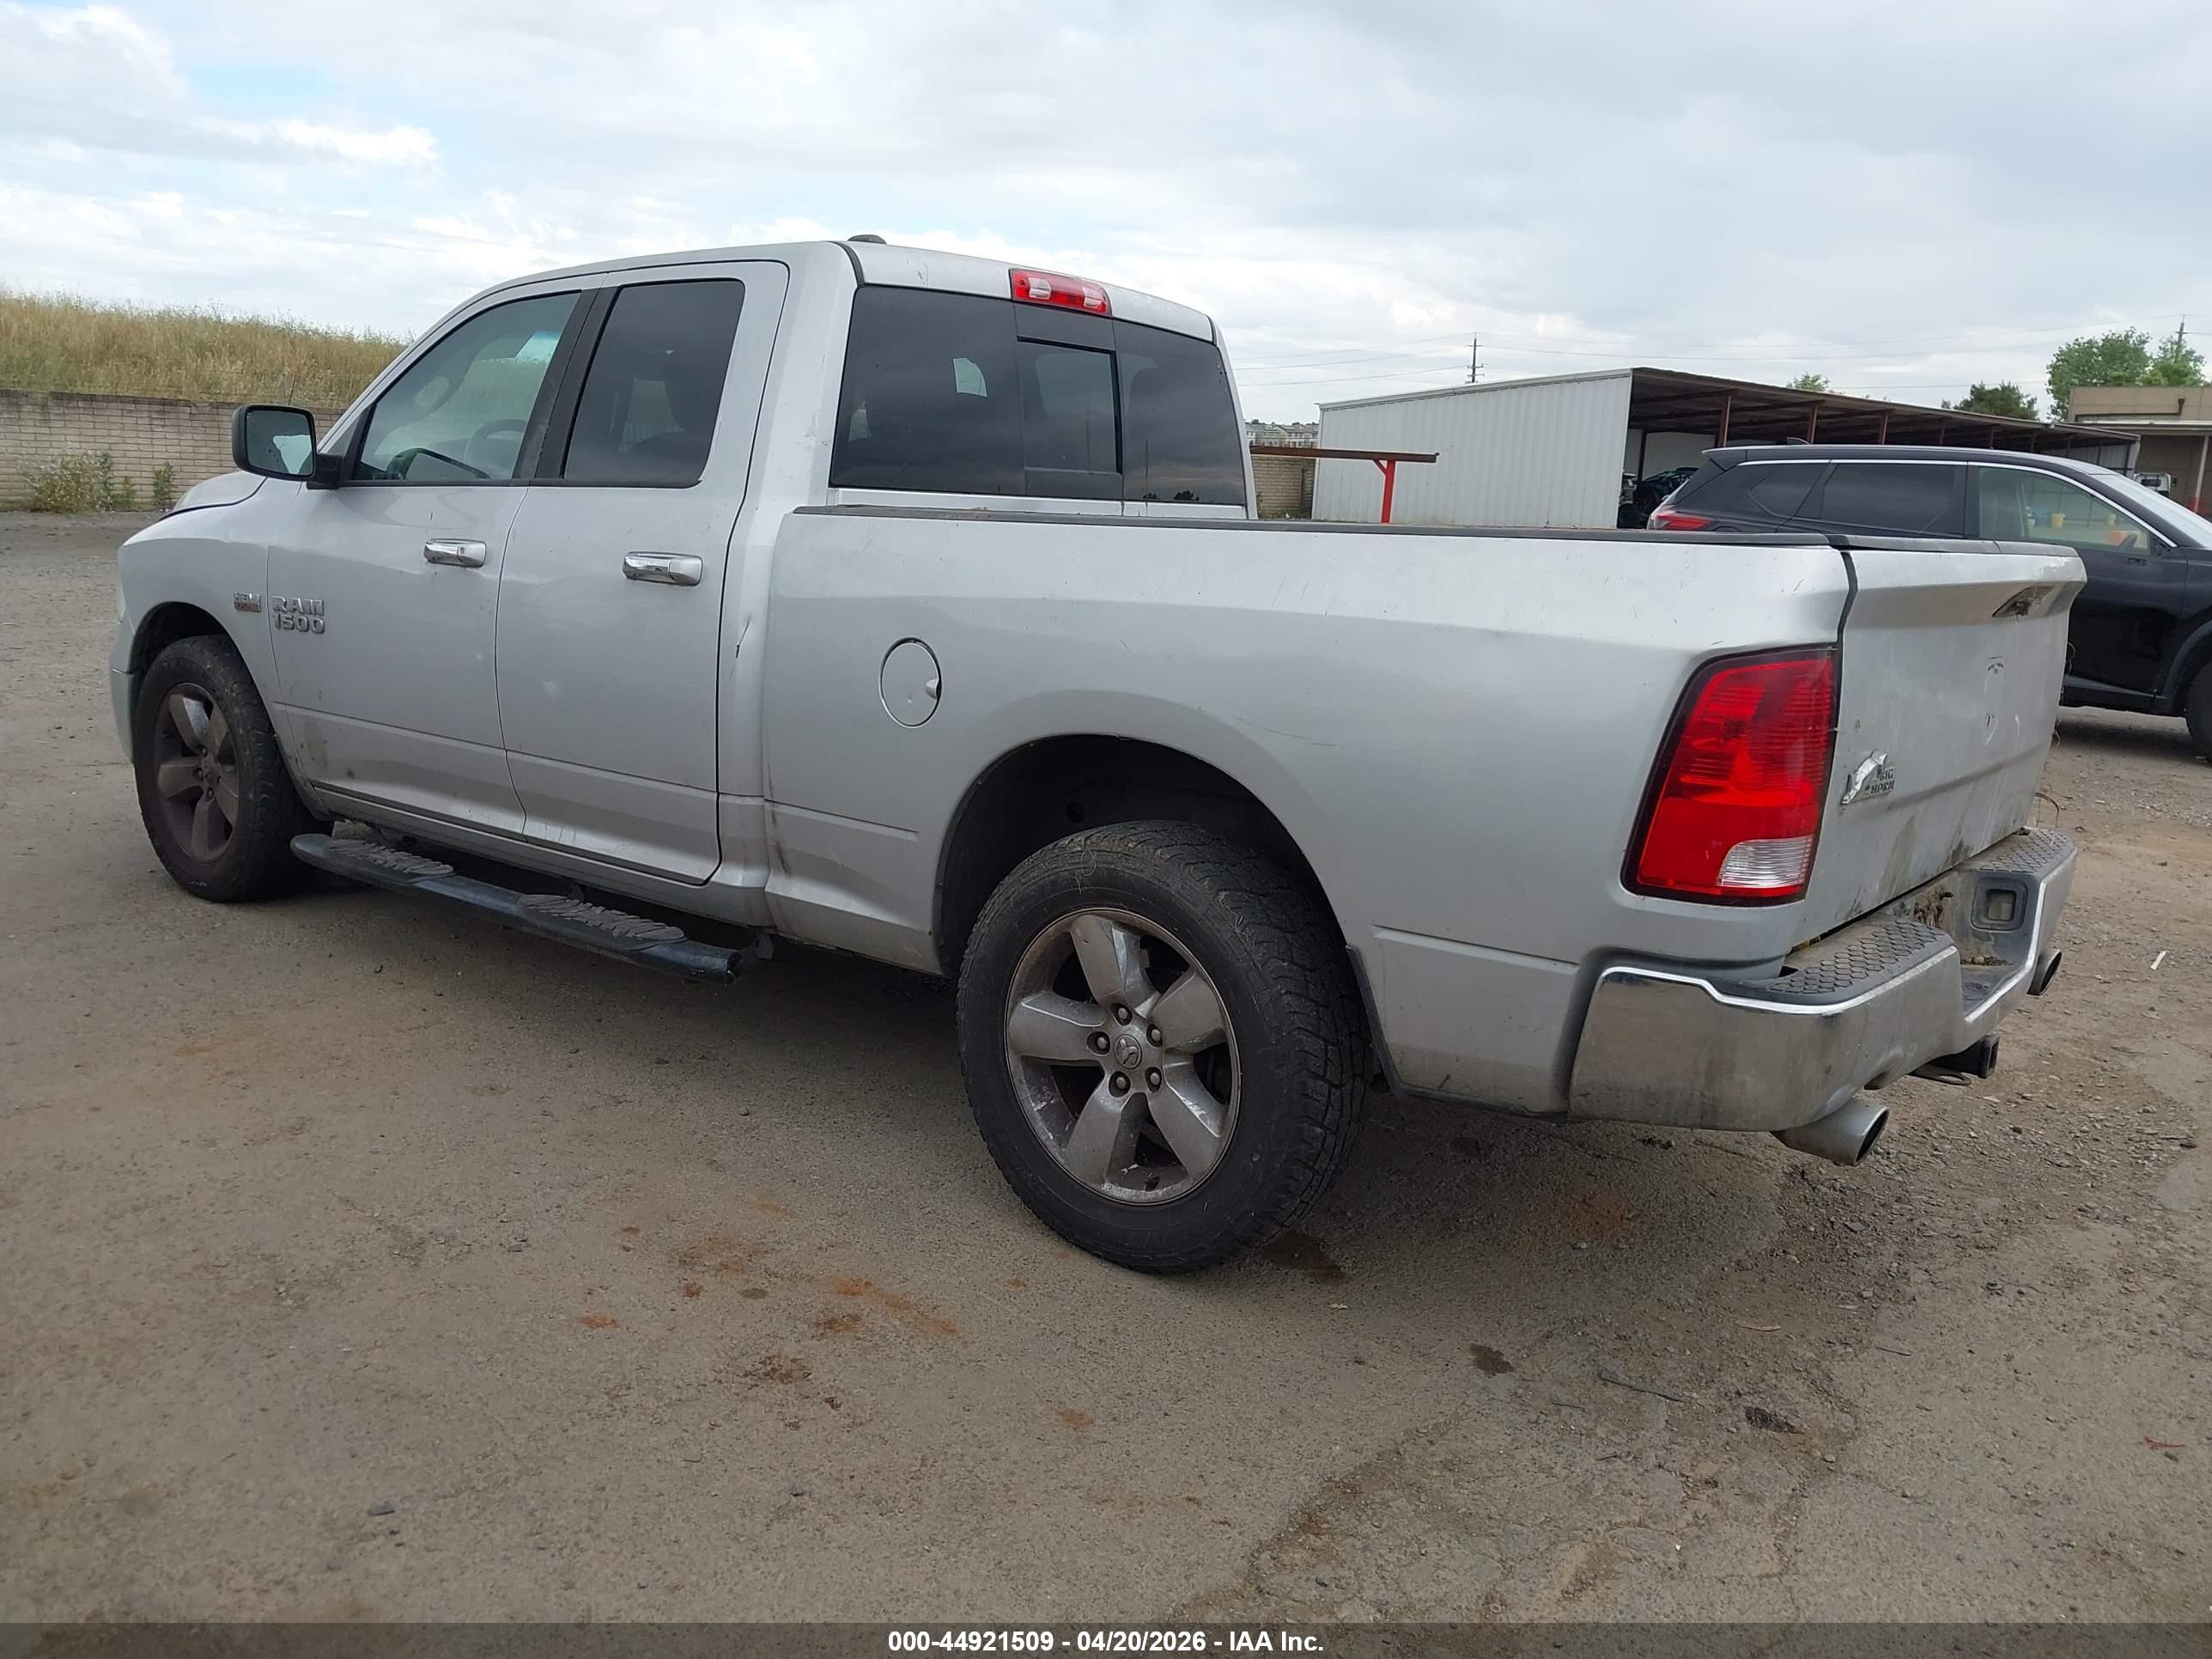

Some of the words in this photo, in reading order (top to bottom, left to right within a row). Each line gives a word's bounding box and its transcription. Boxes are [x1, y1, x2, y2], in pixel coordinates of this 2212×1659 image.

[270, 595, 325, 617] RAM
[273, 613, 325, 634] 1500
[1870, 781, 1895, 794] HORN
